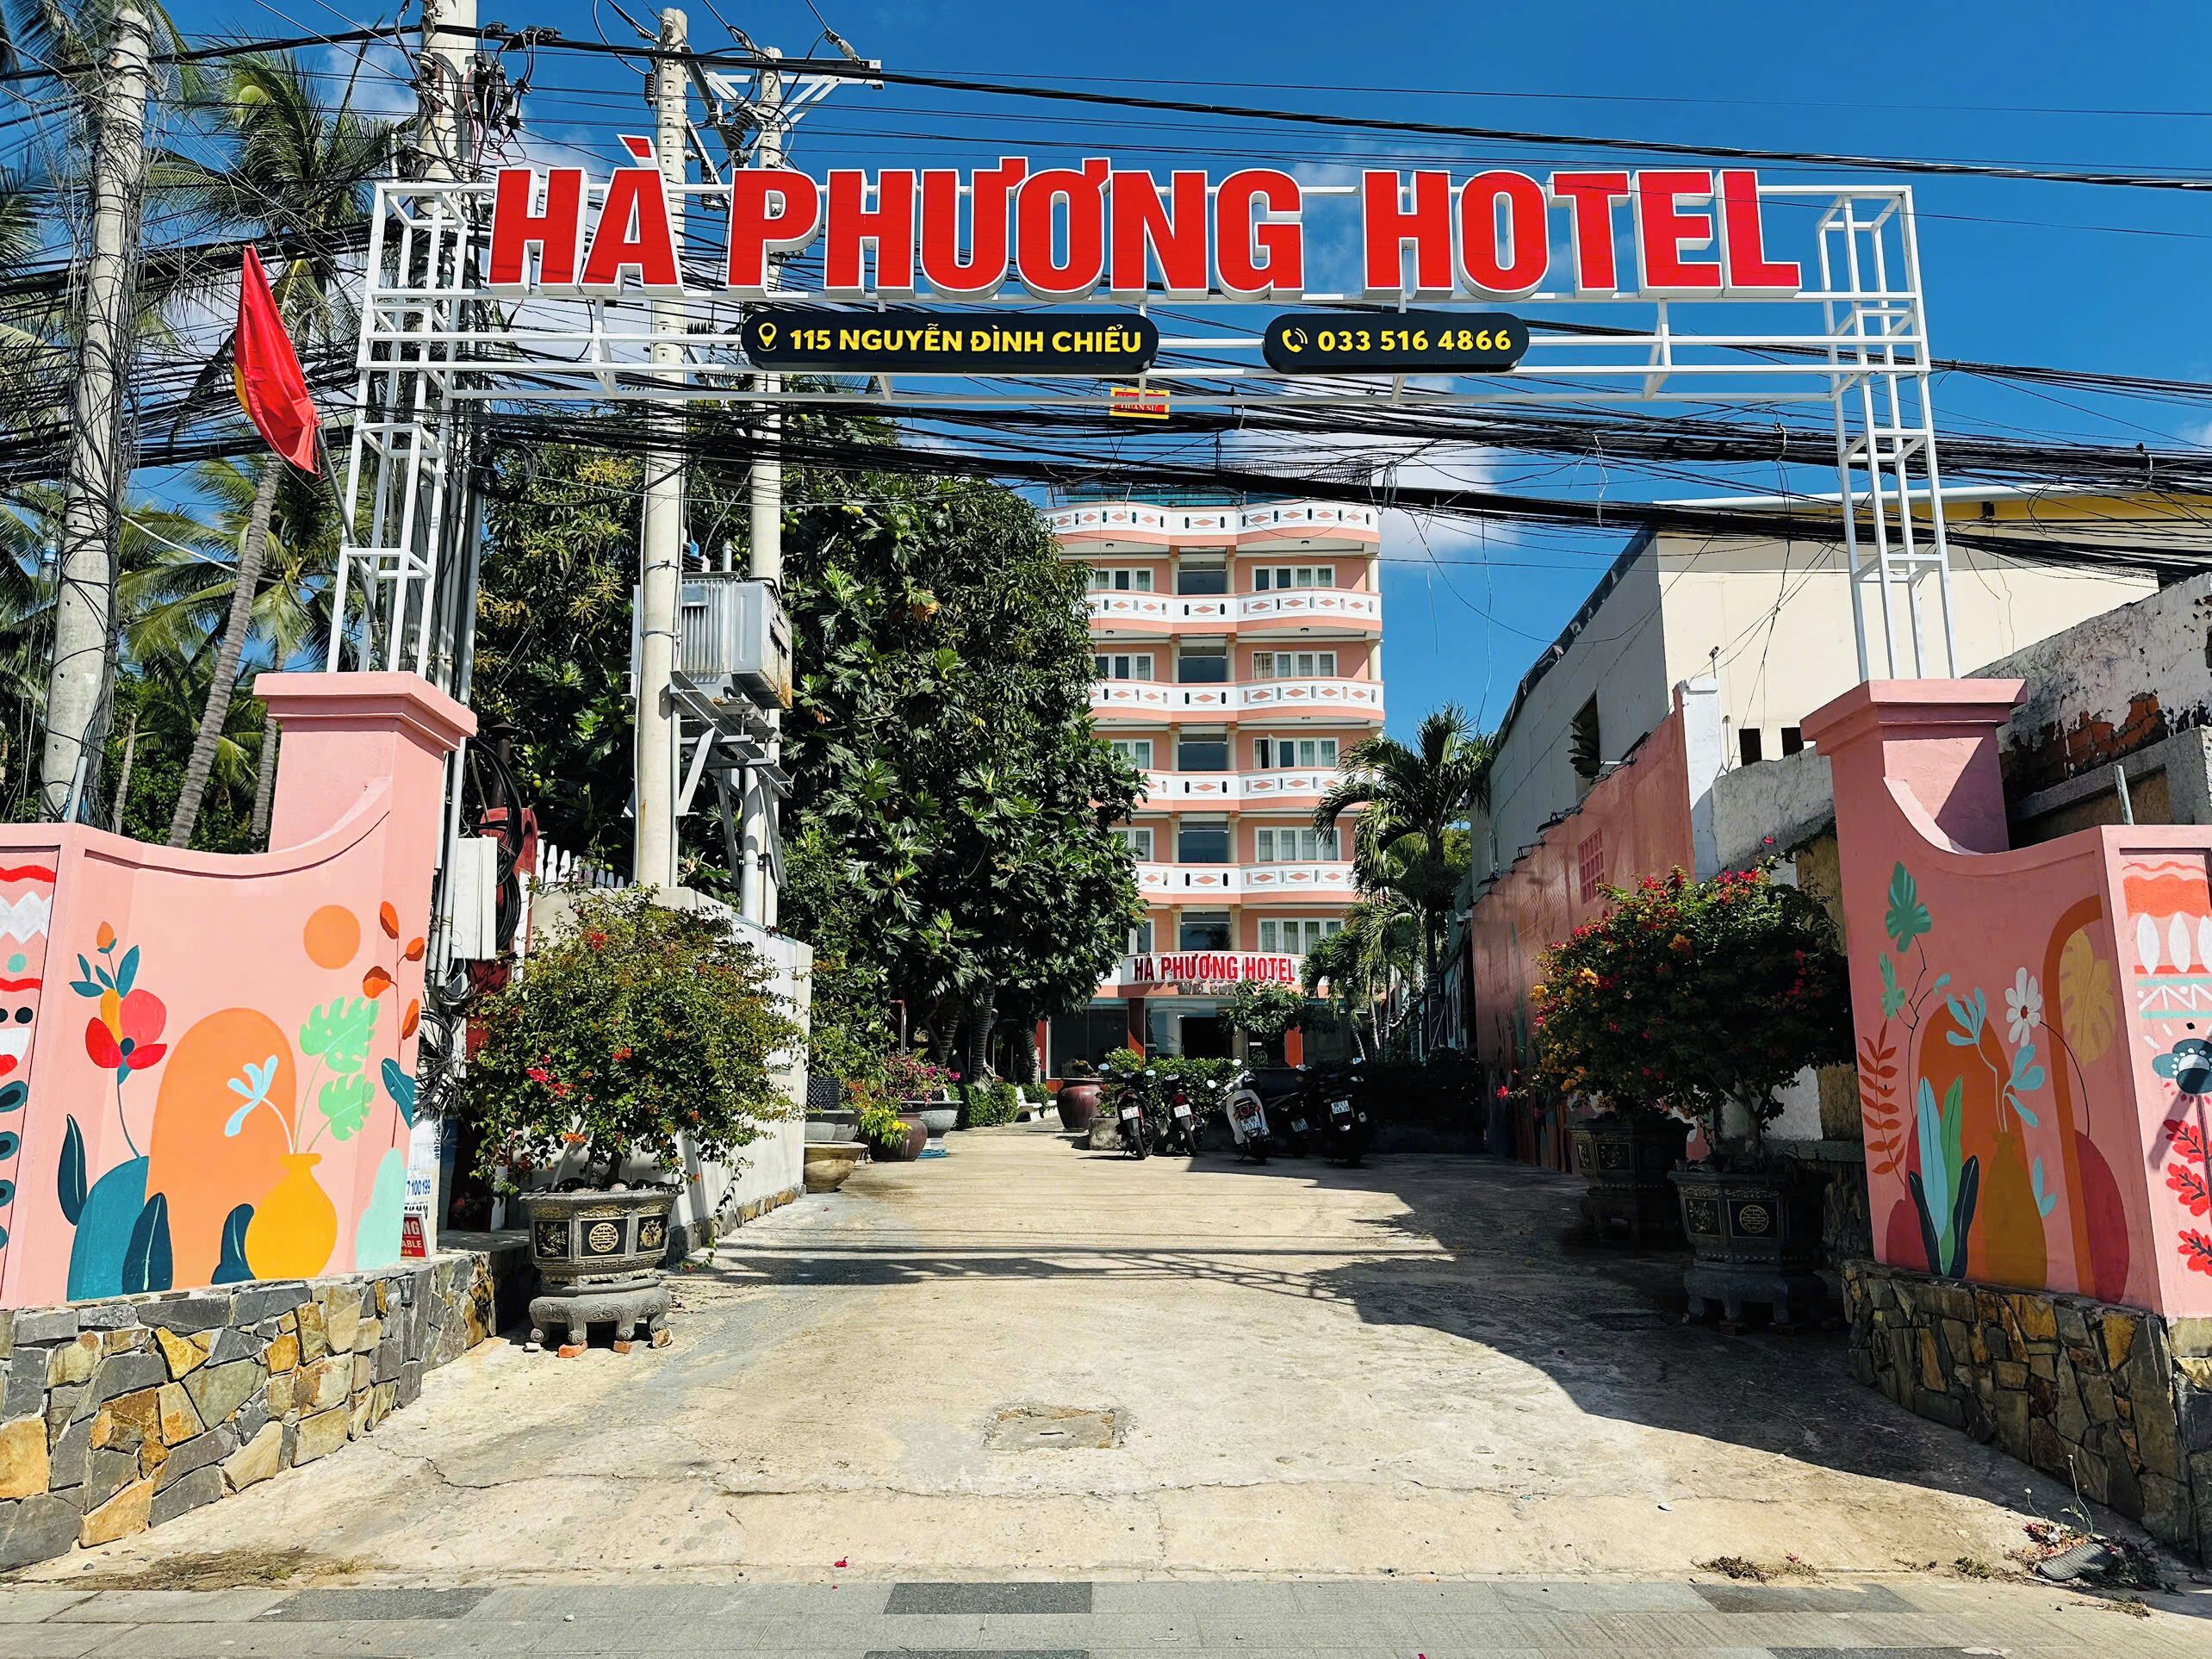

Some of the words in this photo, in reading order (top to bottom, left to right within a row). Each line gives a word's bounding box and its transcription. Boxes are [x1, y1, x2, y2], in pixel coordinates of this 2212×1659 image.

[488, 134, 684, 293] HÀ
[726, 156, 1304, 297] PHƯƠNG
[1361, 167, 1802, 298] HOTEL
[790, 329, 831, 351] 115
[839, 323, 963, 351] NGUYỄN
[970, 324, 1043, 352] ĐÌNH
[1052, 324, 1142, 353] CHIỂU
[1318, 331, 1371, 351] 033
[1380, 330, 1429, 351] 516
[1438, 330, 1512, 351] 4866
[1134, 953, 1154, 981] HÀ
[1161, 954, 1238, 979] PHƯƠNG
[1245, 957, 1295, 982] HOTEL
